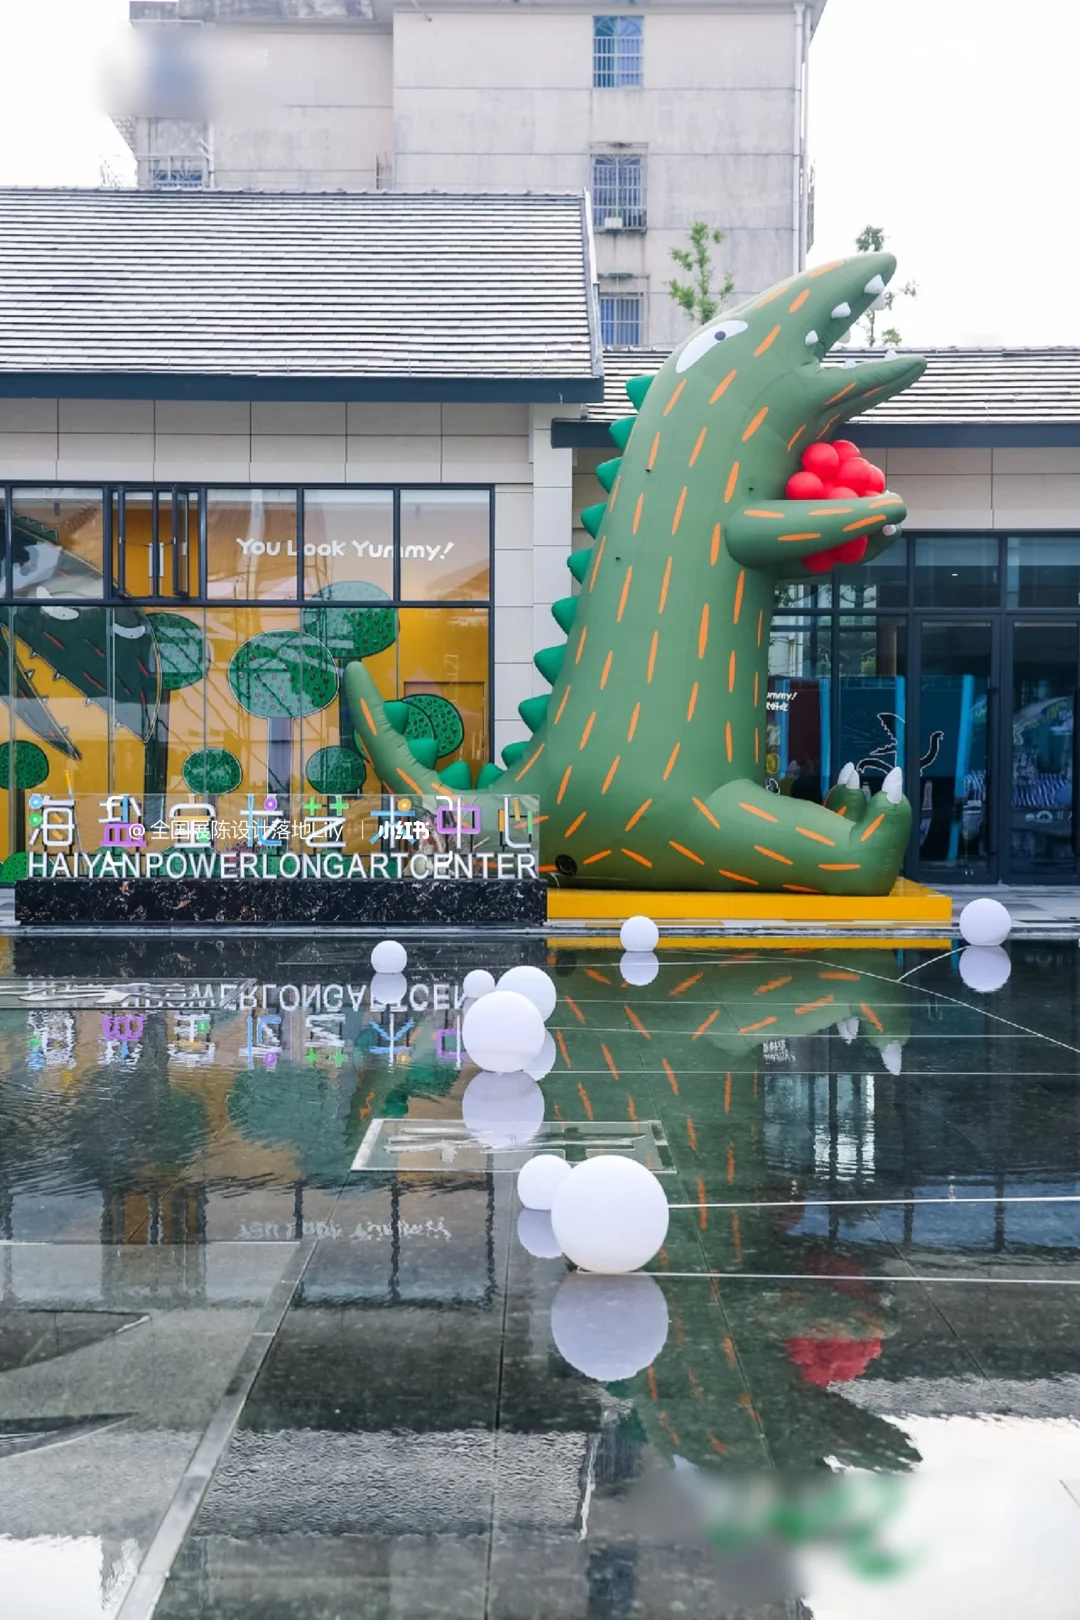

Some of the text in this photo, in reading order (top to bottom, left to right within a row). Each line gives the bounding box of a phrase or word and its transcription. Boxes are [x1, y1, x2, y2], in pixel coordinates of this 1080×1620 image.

[236, 538, 455, 561] You Look Yummy!
